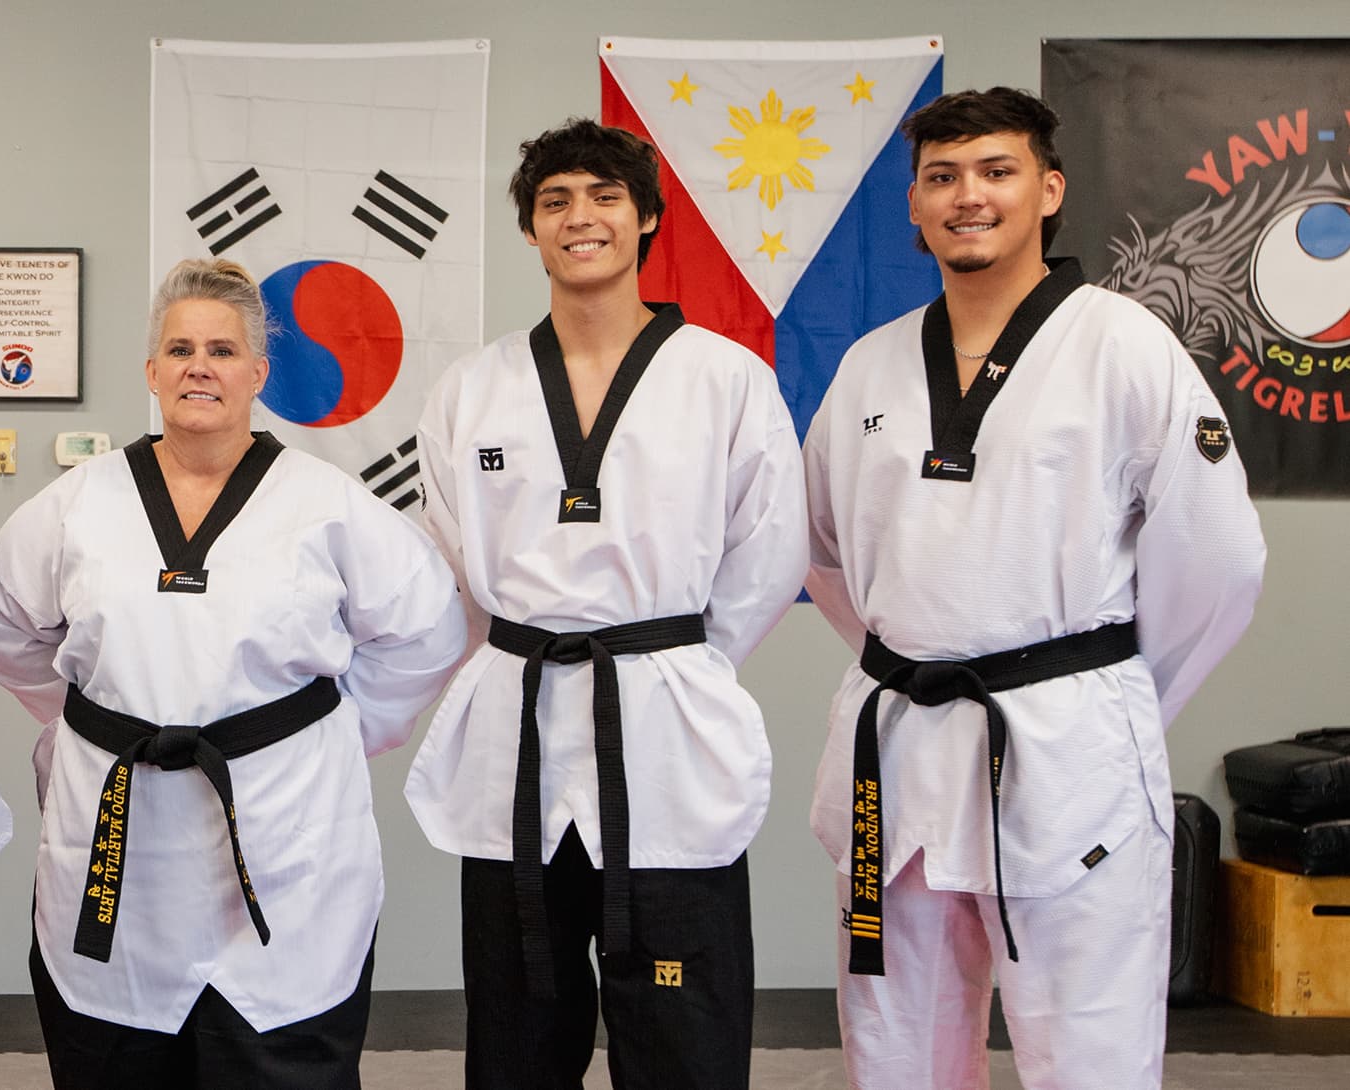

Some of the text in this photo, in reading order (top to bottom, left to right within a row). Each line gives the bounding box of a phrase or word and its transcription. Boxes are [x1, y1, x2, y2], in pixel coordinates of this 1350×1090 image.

[16, 260, 55, 268] TENETS
[97, 766, 129, 924] SUNDO MARTIAL ARTS
[865, 779, 879, 902] BRANDON RAIZ
